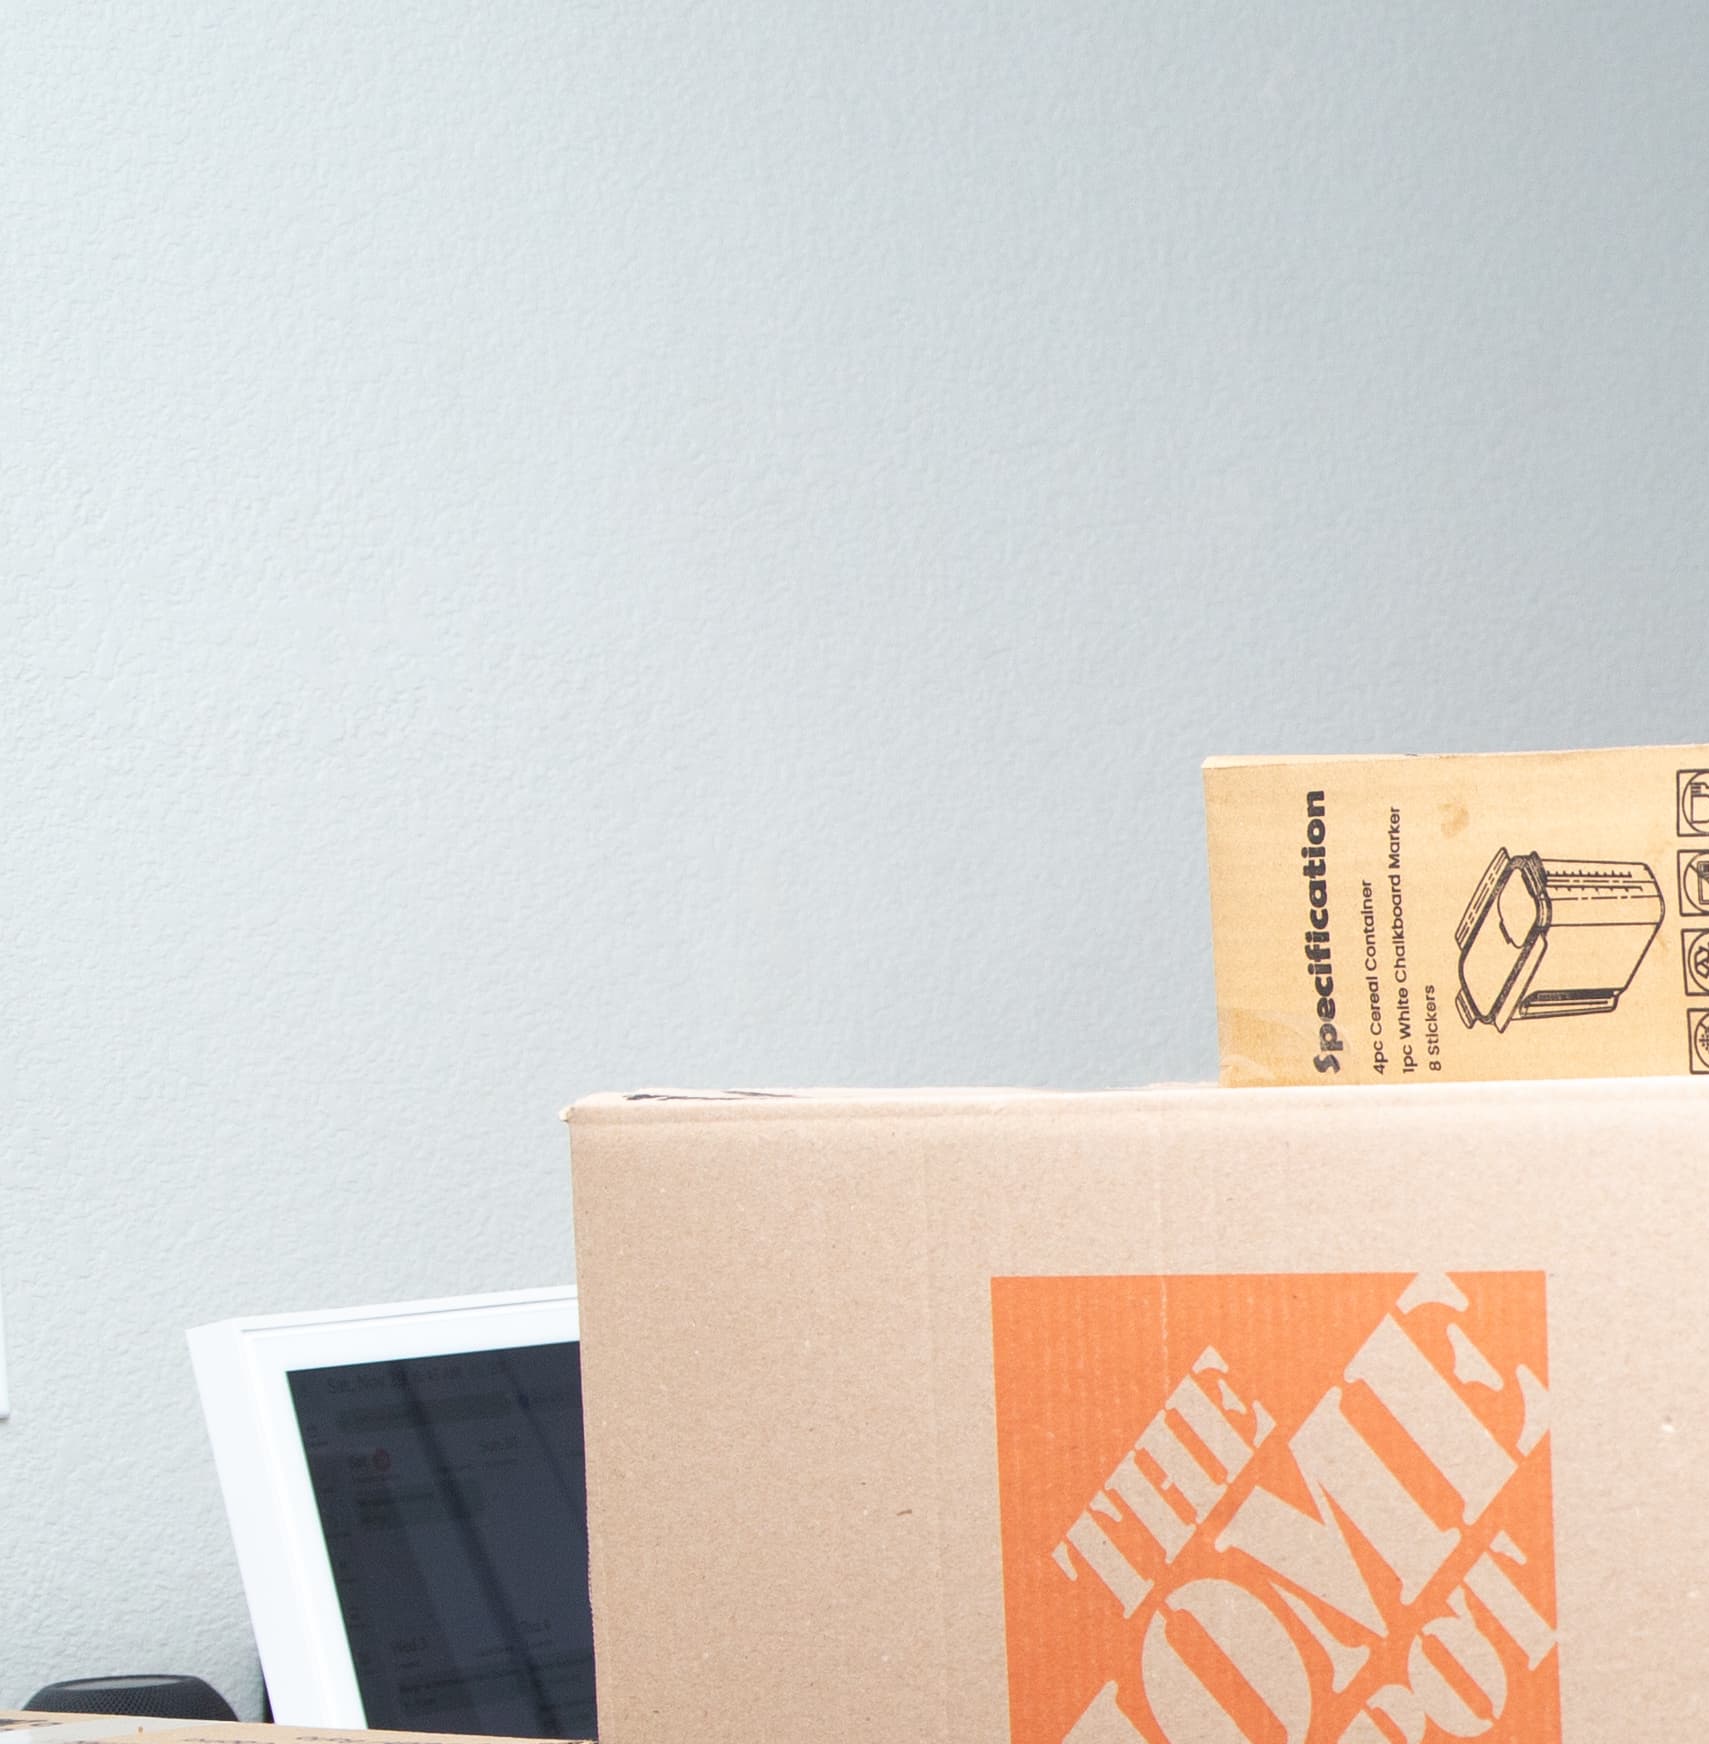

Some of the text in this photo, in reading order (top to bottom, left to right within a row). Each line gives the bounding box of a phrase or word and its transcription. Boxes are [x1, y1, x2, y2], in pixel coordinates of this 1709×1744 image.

[1302, 790, 1344, 1074] Specification
[1361, 879, 1388, 1075] 4pc Cereal Container
[1388, 806, 1418, 1074] 1pc White Chalkboard Marker
[1425, 984, 1442, 1072] 8 Stickers
[1050, 1344, 1278, 1620] THE
